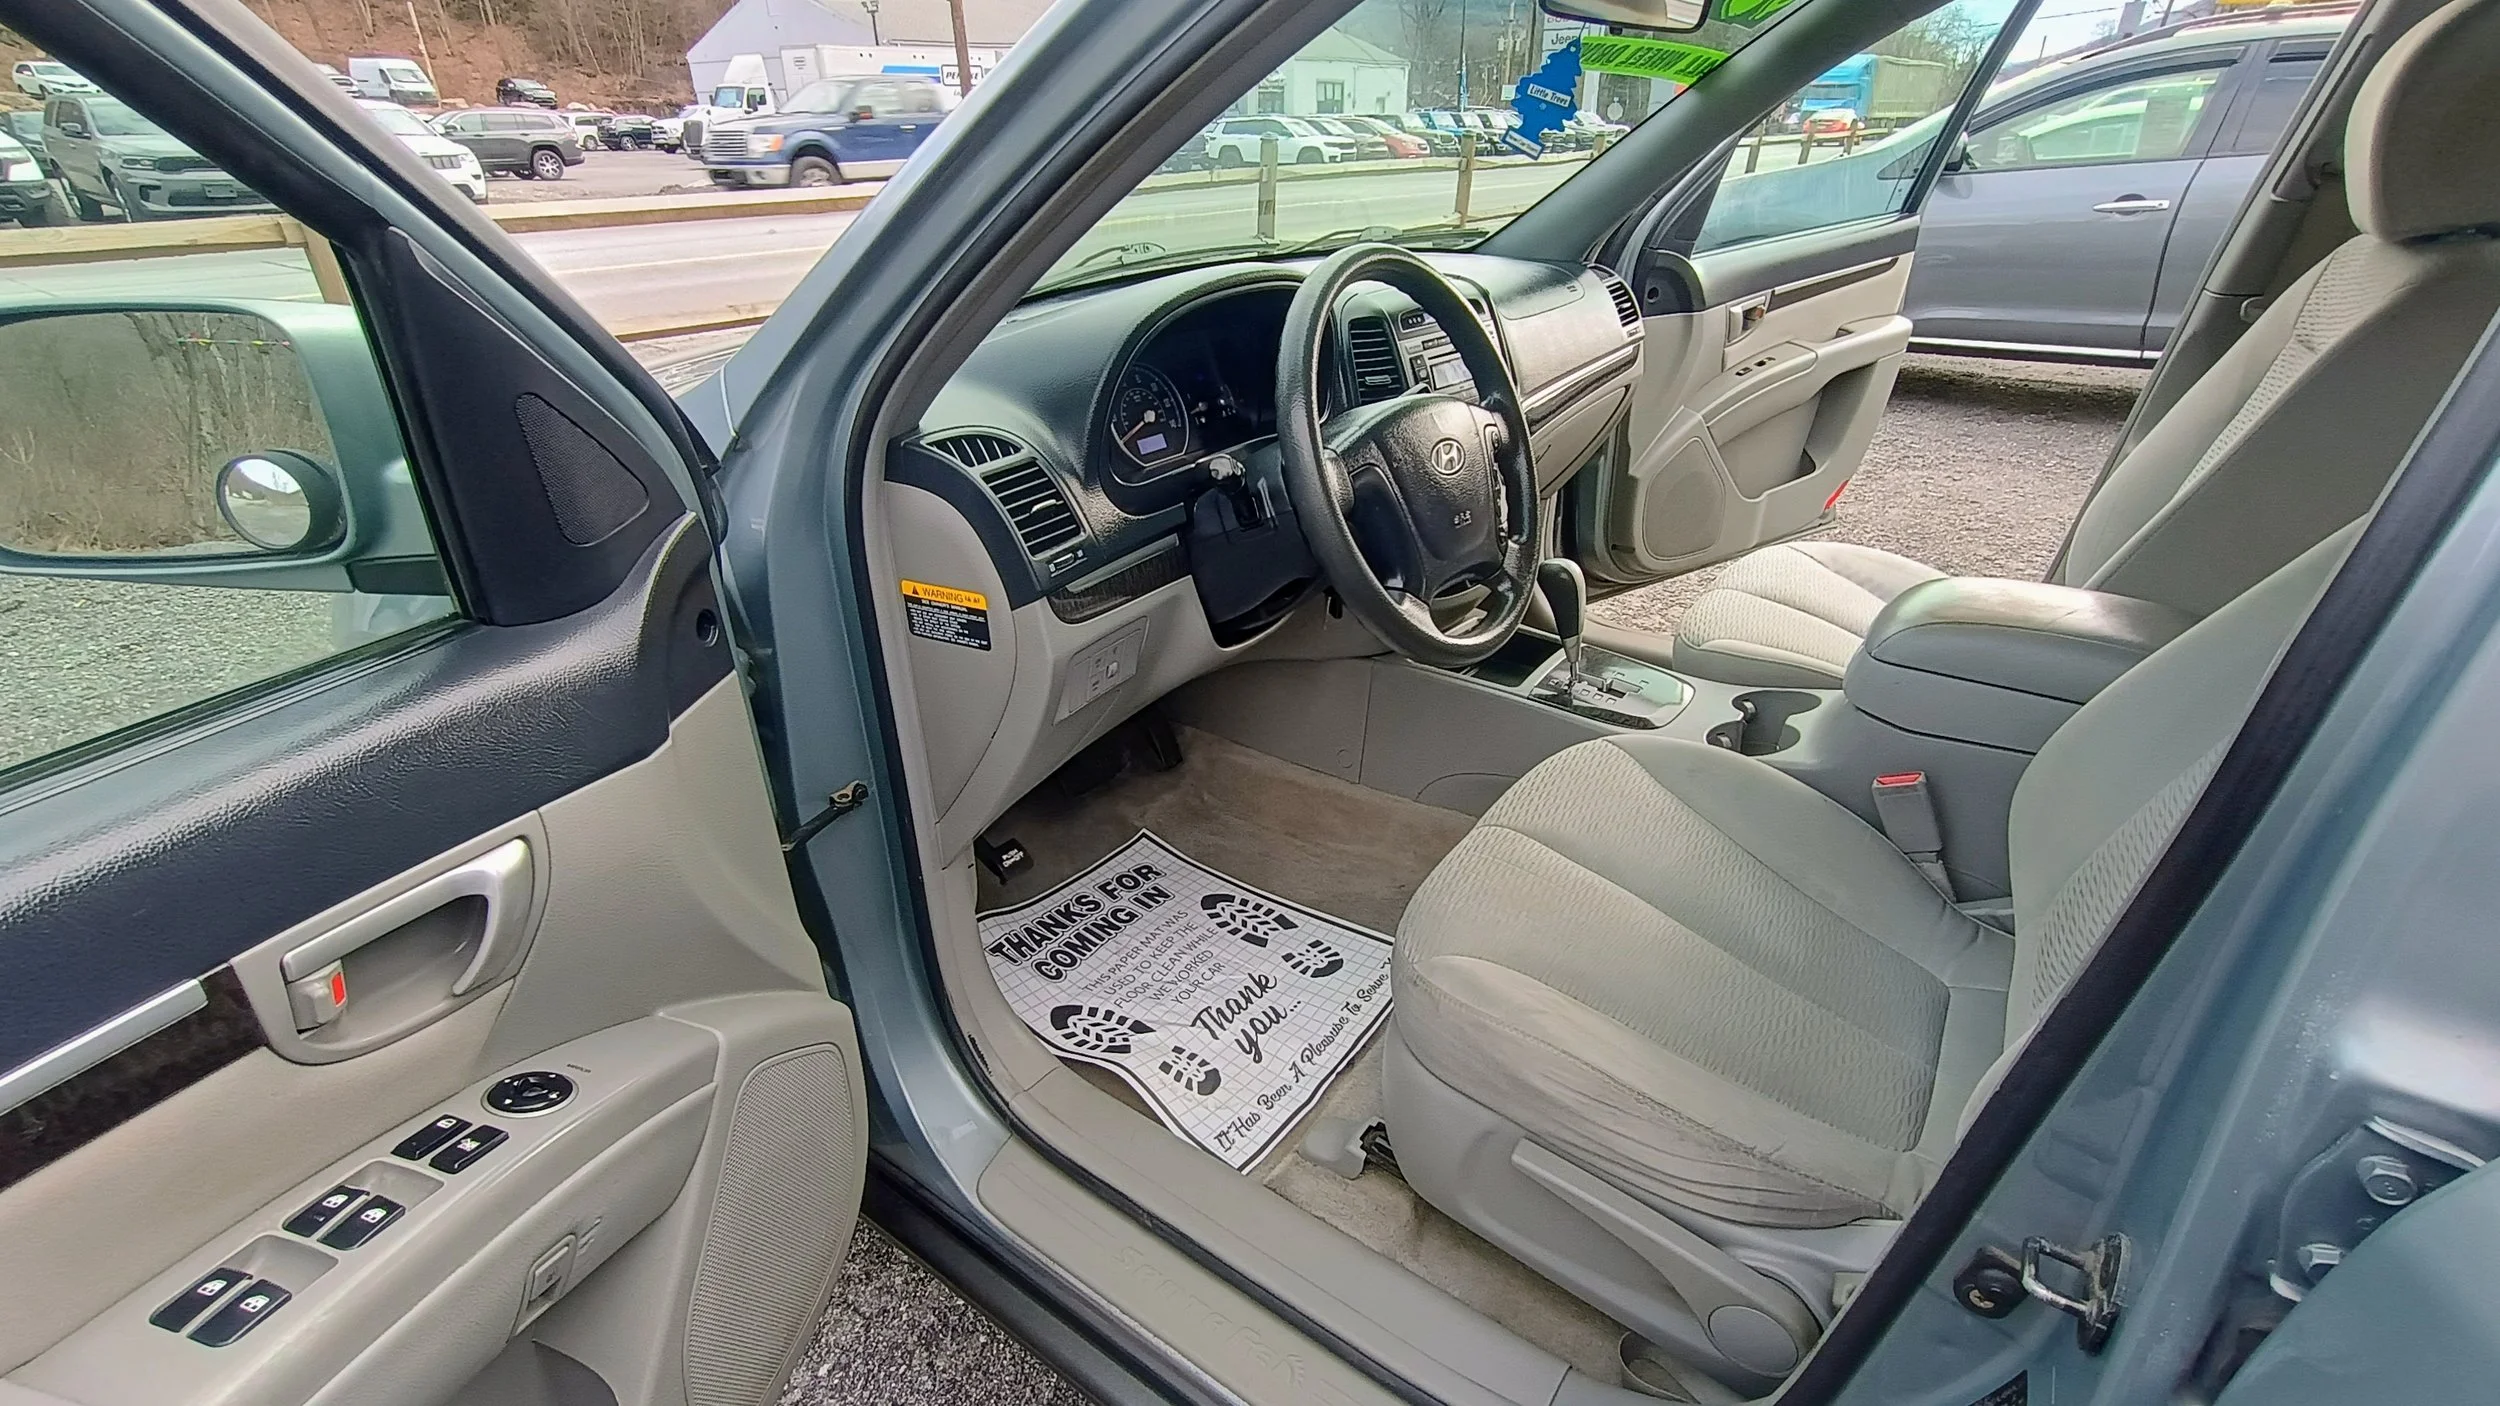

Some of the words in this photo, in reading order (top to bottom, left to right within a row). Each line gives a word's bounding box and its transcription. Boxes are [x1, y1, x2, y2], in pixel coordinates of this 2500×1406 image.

[1529, 85, 1548, 98] Little
[1550, 92, 1569, 106] Trees
[922, 586, 964, 604] WARNING
[985, 893, 1104, 965] THANKS
[1093, 862, 1166, 903] FOR
[1031, 905, 1142, 983] COMING
[1129, 883, 1175, 912] IN
[1082, 973, 1111, 992] THIS
[1108, 946, 1143, 975] PAPER
[1140, 925, 1164, 948] MAT
[1161, 909, 1189, 933] WAS
[1104, 974, 1136, 995] USED
[1133, 960, 1151, 975] TO
[1150, 936, 1176, 960] KEEP
[1173, 921, 1199, 939] THE
[1113, 981, 1154, 1009] FLOOR
[1151, 949, 1188, 983] CLEAN
[1182, 926, 1219, 952] WHILE
[1150, 984, 1172, 1002] WE
[1169, 950, 1214, 986] WORKED
[1170, 979, 1205, 1006] YOUR
[1201, 962, 1226, 982] CAR
[1190, 973, 1277, 1040] Thank
[1213, 1130, 1235, 1152] It
[1226, 1111, 1261, 1138] Has
[1257, 1081, 1292, 1110] Been
[1289, 1061, 1307, 1083] A
[1300, 1014, 1350, 1065] Pleasure
[1341, 1001, 1363, 1016] To
[1356, 974, 1389, 1002] Serve
